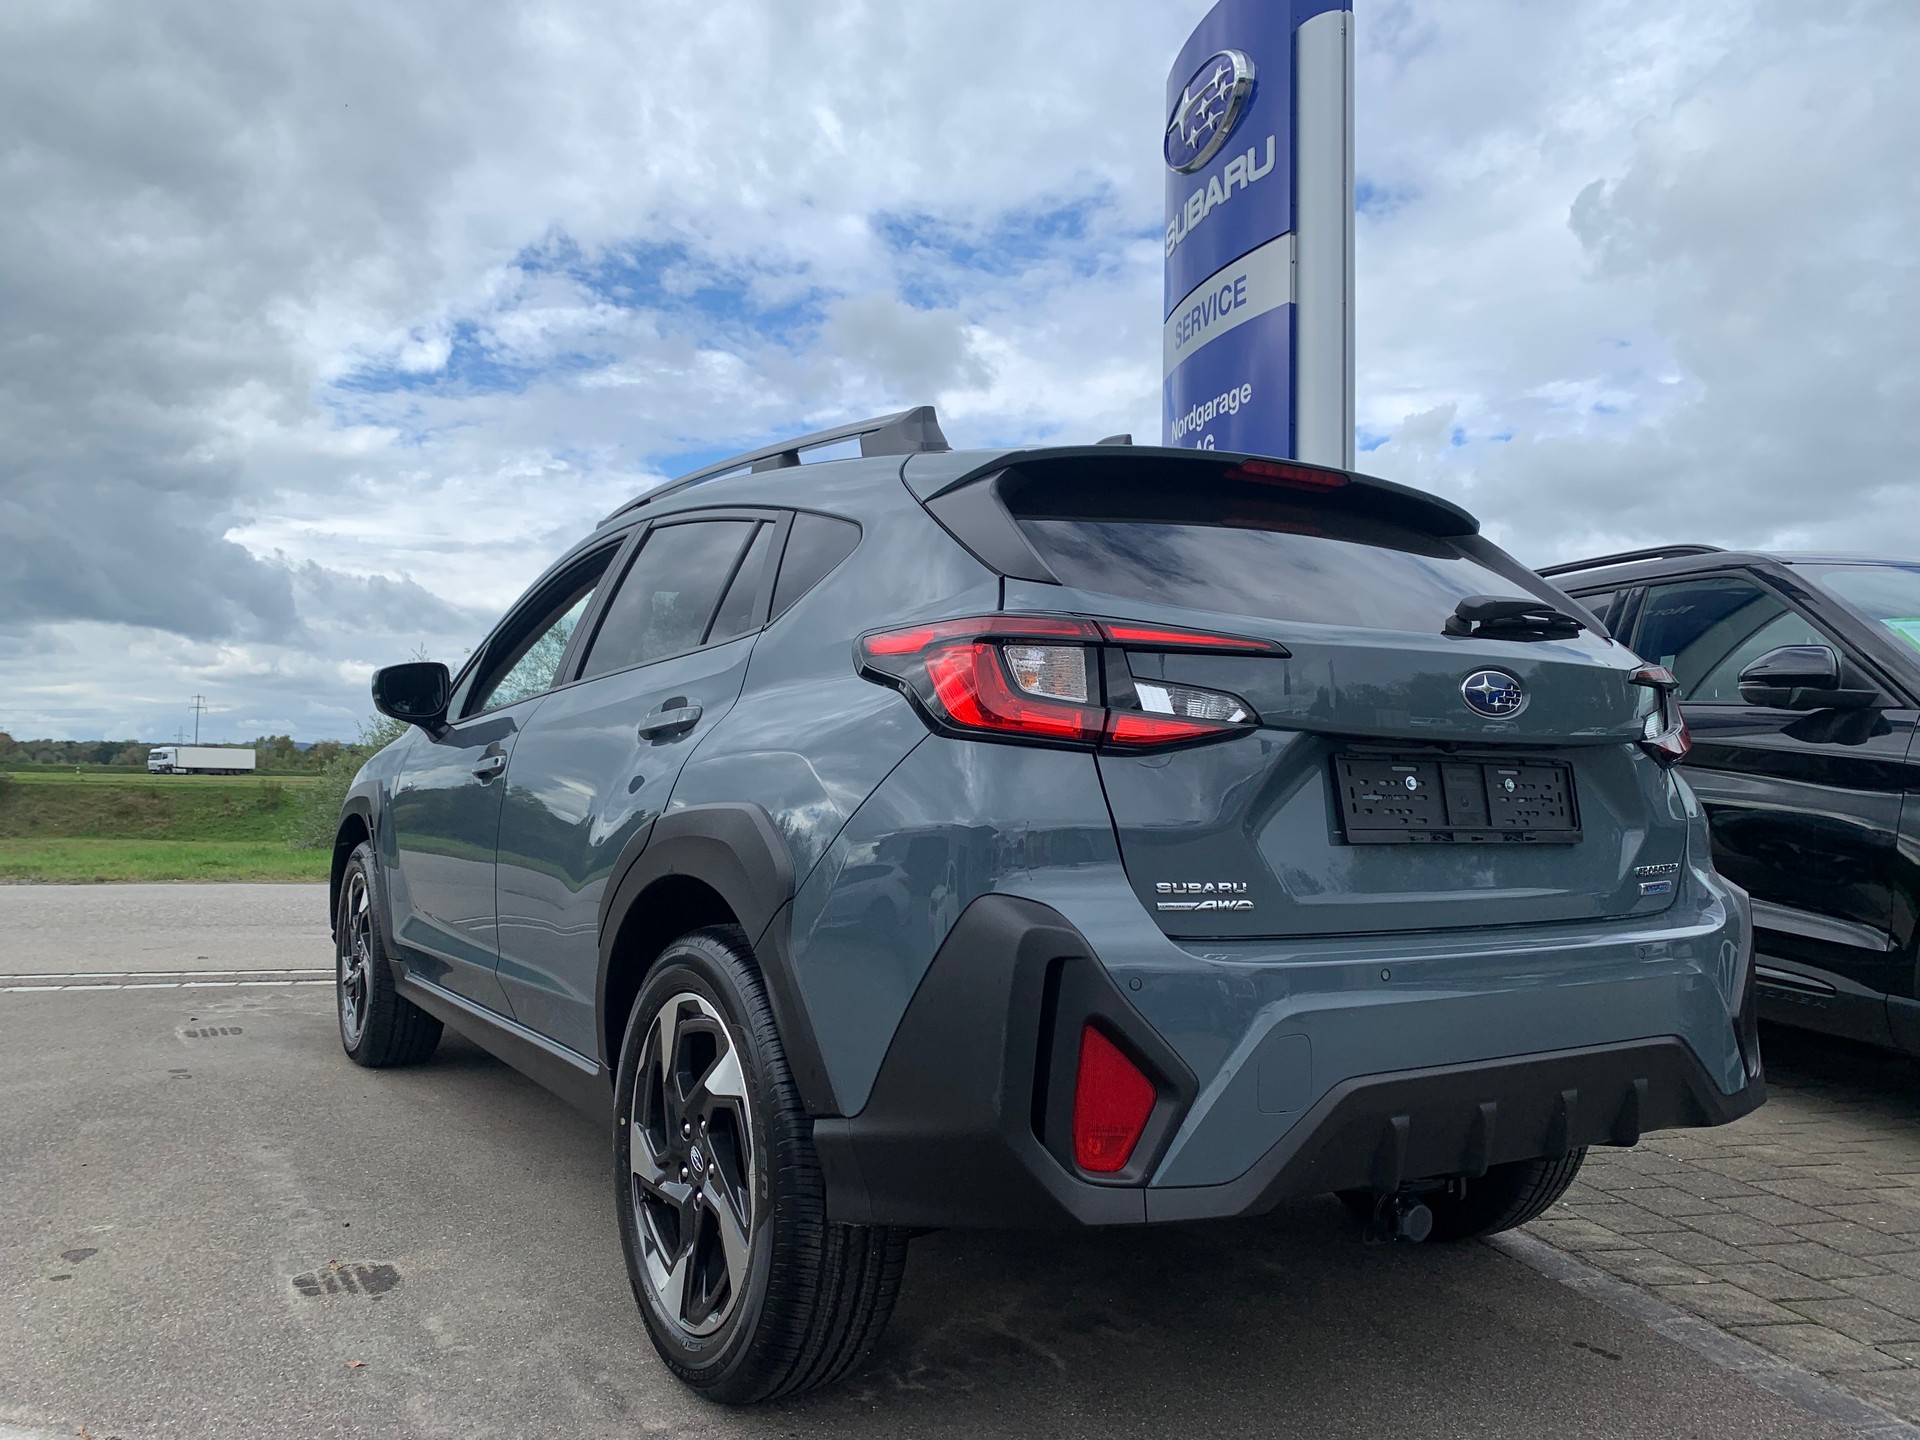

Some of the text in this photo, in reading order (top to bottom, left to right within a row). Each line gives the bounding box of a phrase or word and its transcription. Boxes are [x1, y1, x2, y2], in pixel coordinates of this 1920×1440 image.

[1165, 134, 1276, 259] SUBARU
[1174, 274, 1247, 350] SERVICE
[1171, 382, 1252, 444] Nordgarage
[1156, 882, 1247, 893] SUBARU
[1194, 900, 1254, 910] AWD
